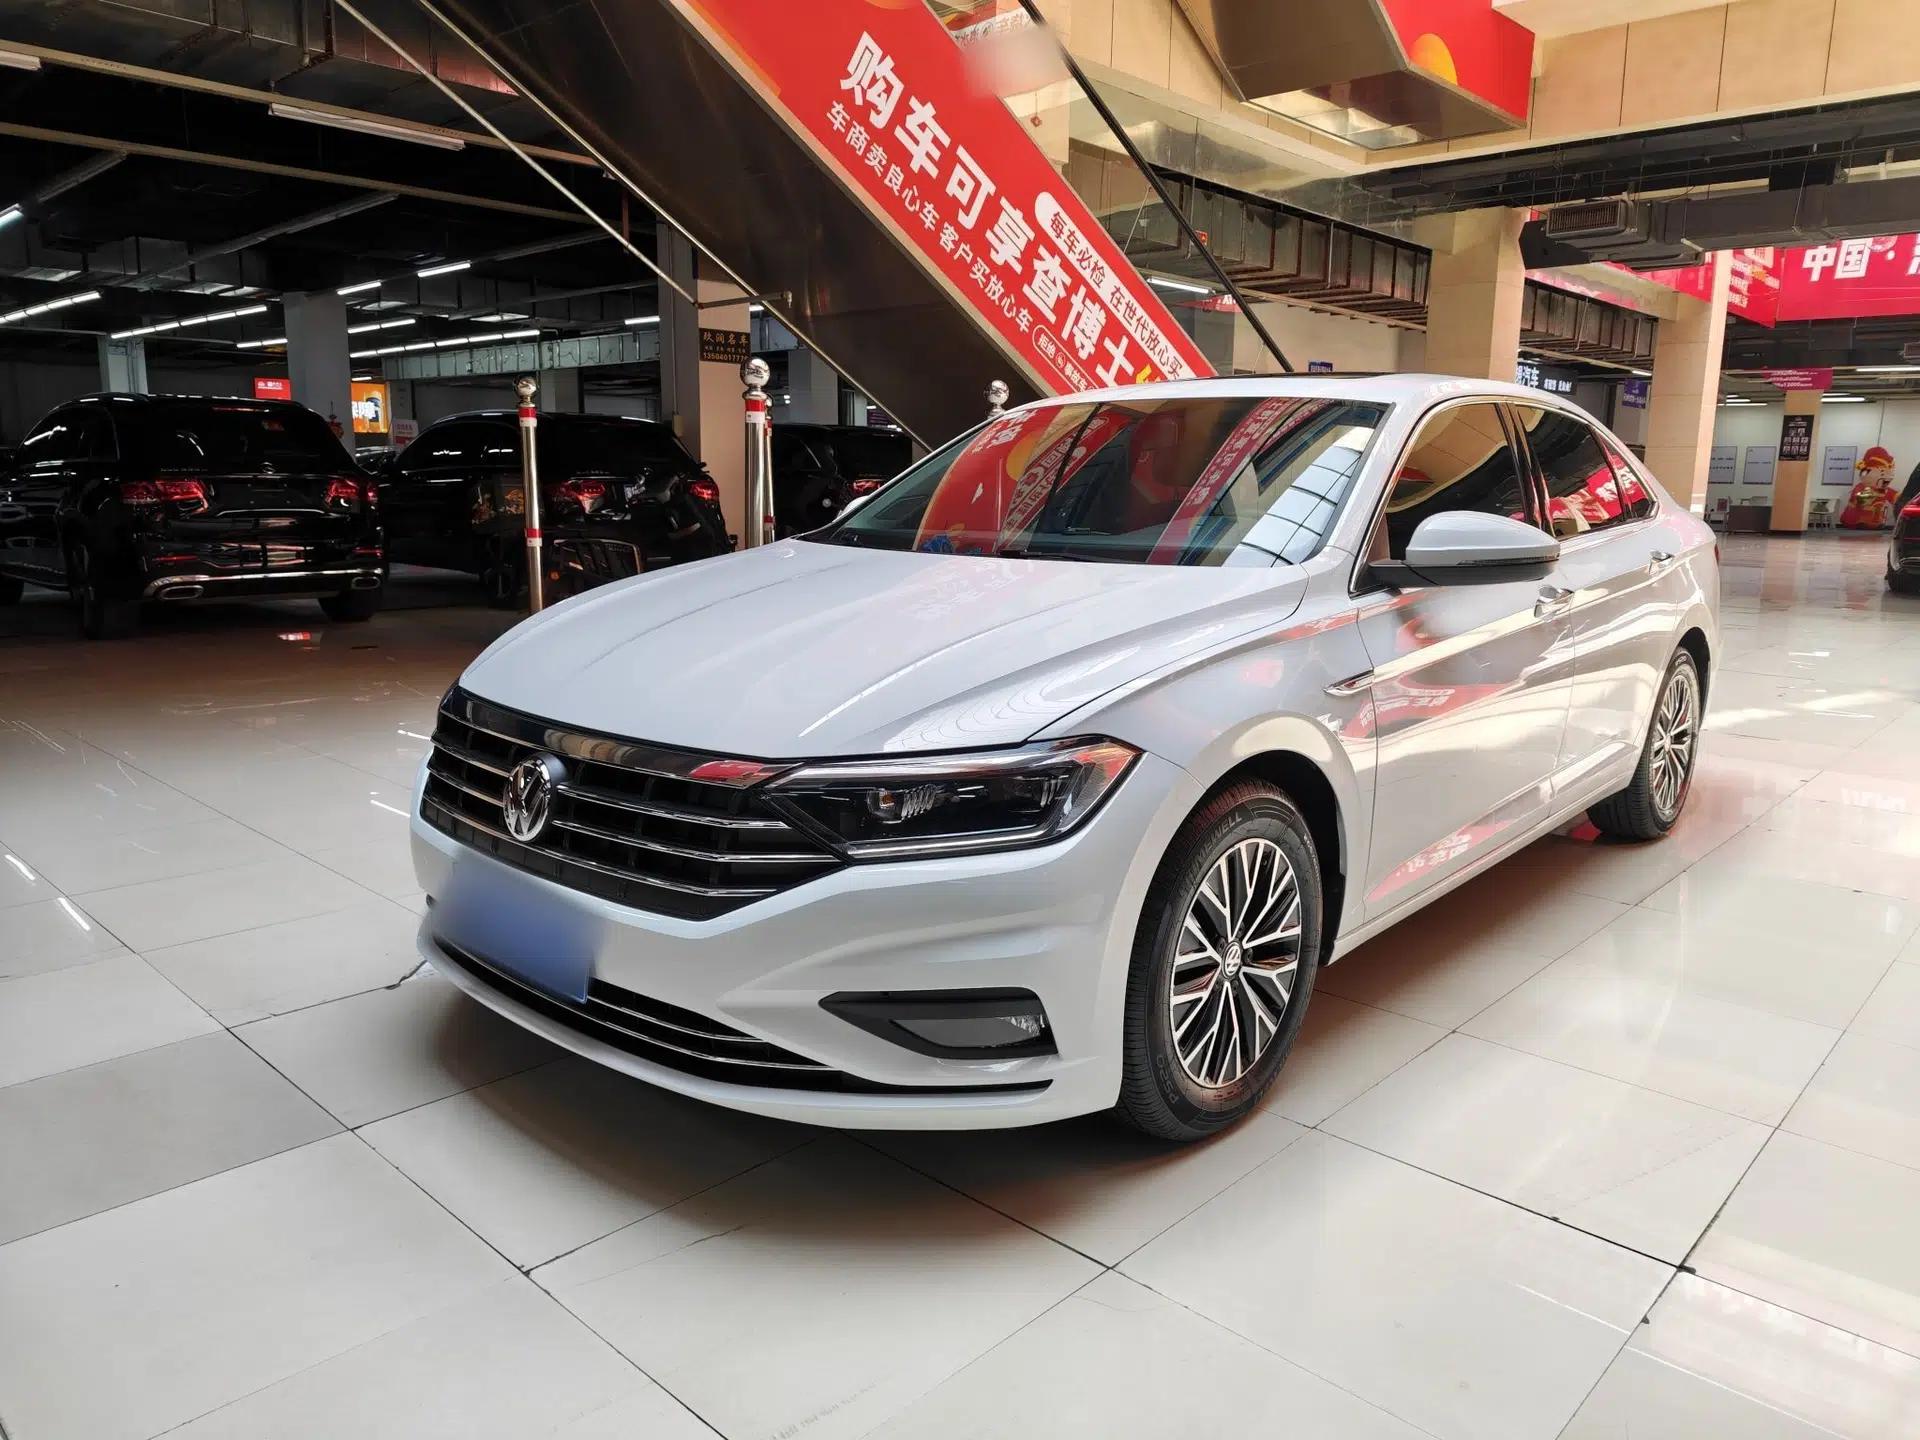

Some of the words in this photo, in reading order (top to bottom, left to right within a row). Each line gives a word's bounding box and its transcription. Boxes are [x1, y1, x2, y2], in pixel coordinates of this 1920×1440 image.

[839, 31, 1135, 388] 购车可享查博士
[1050, 211, 1106, 289] 每车必检
[1110, 284, 1183, 380] 在世代放心买
